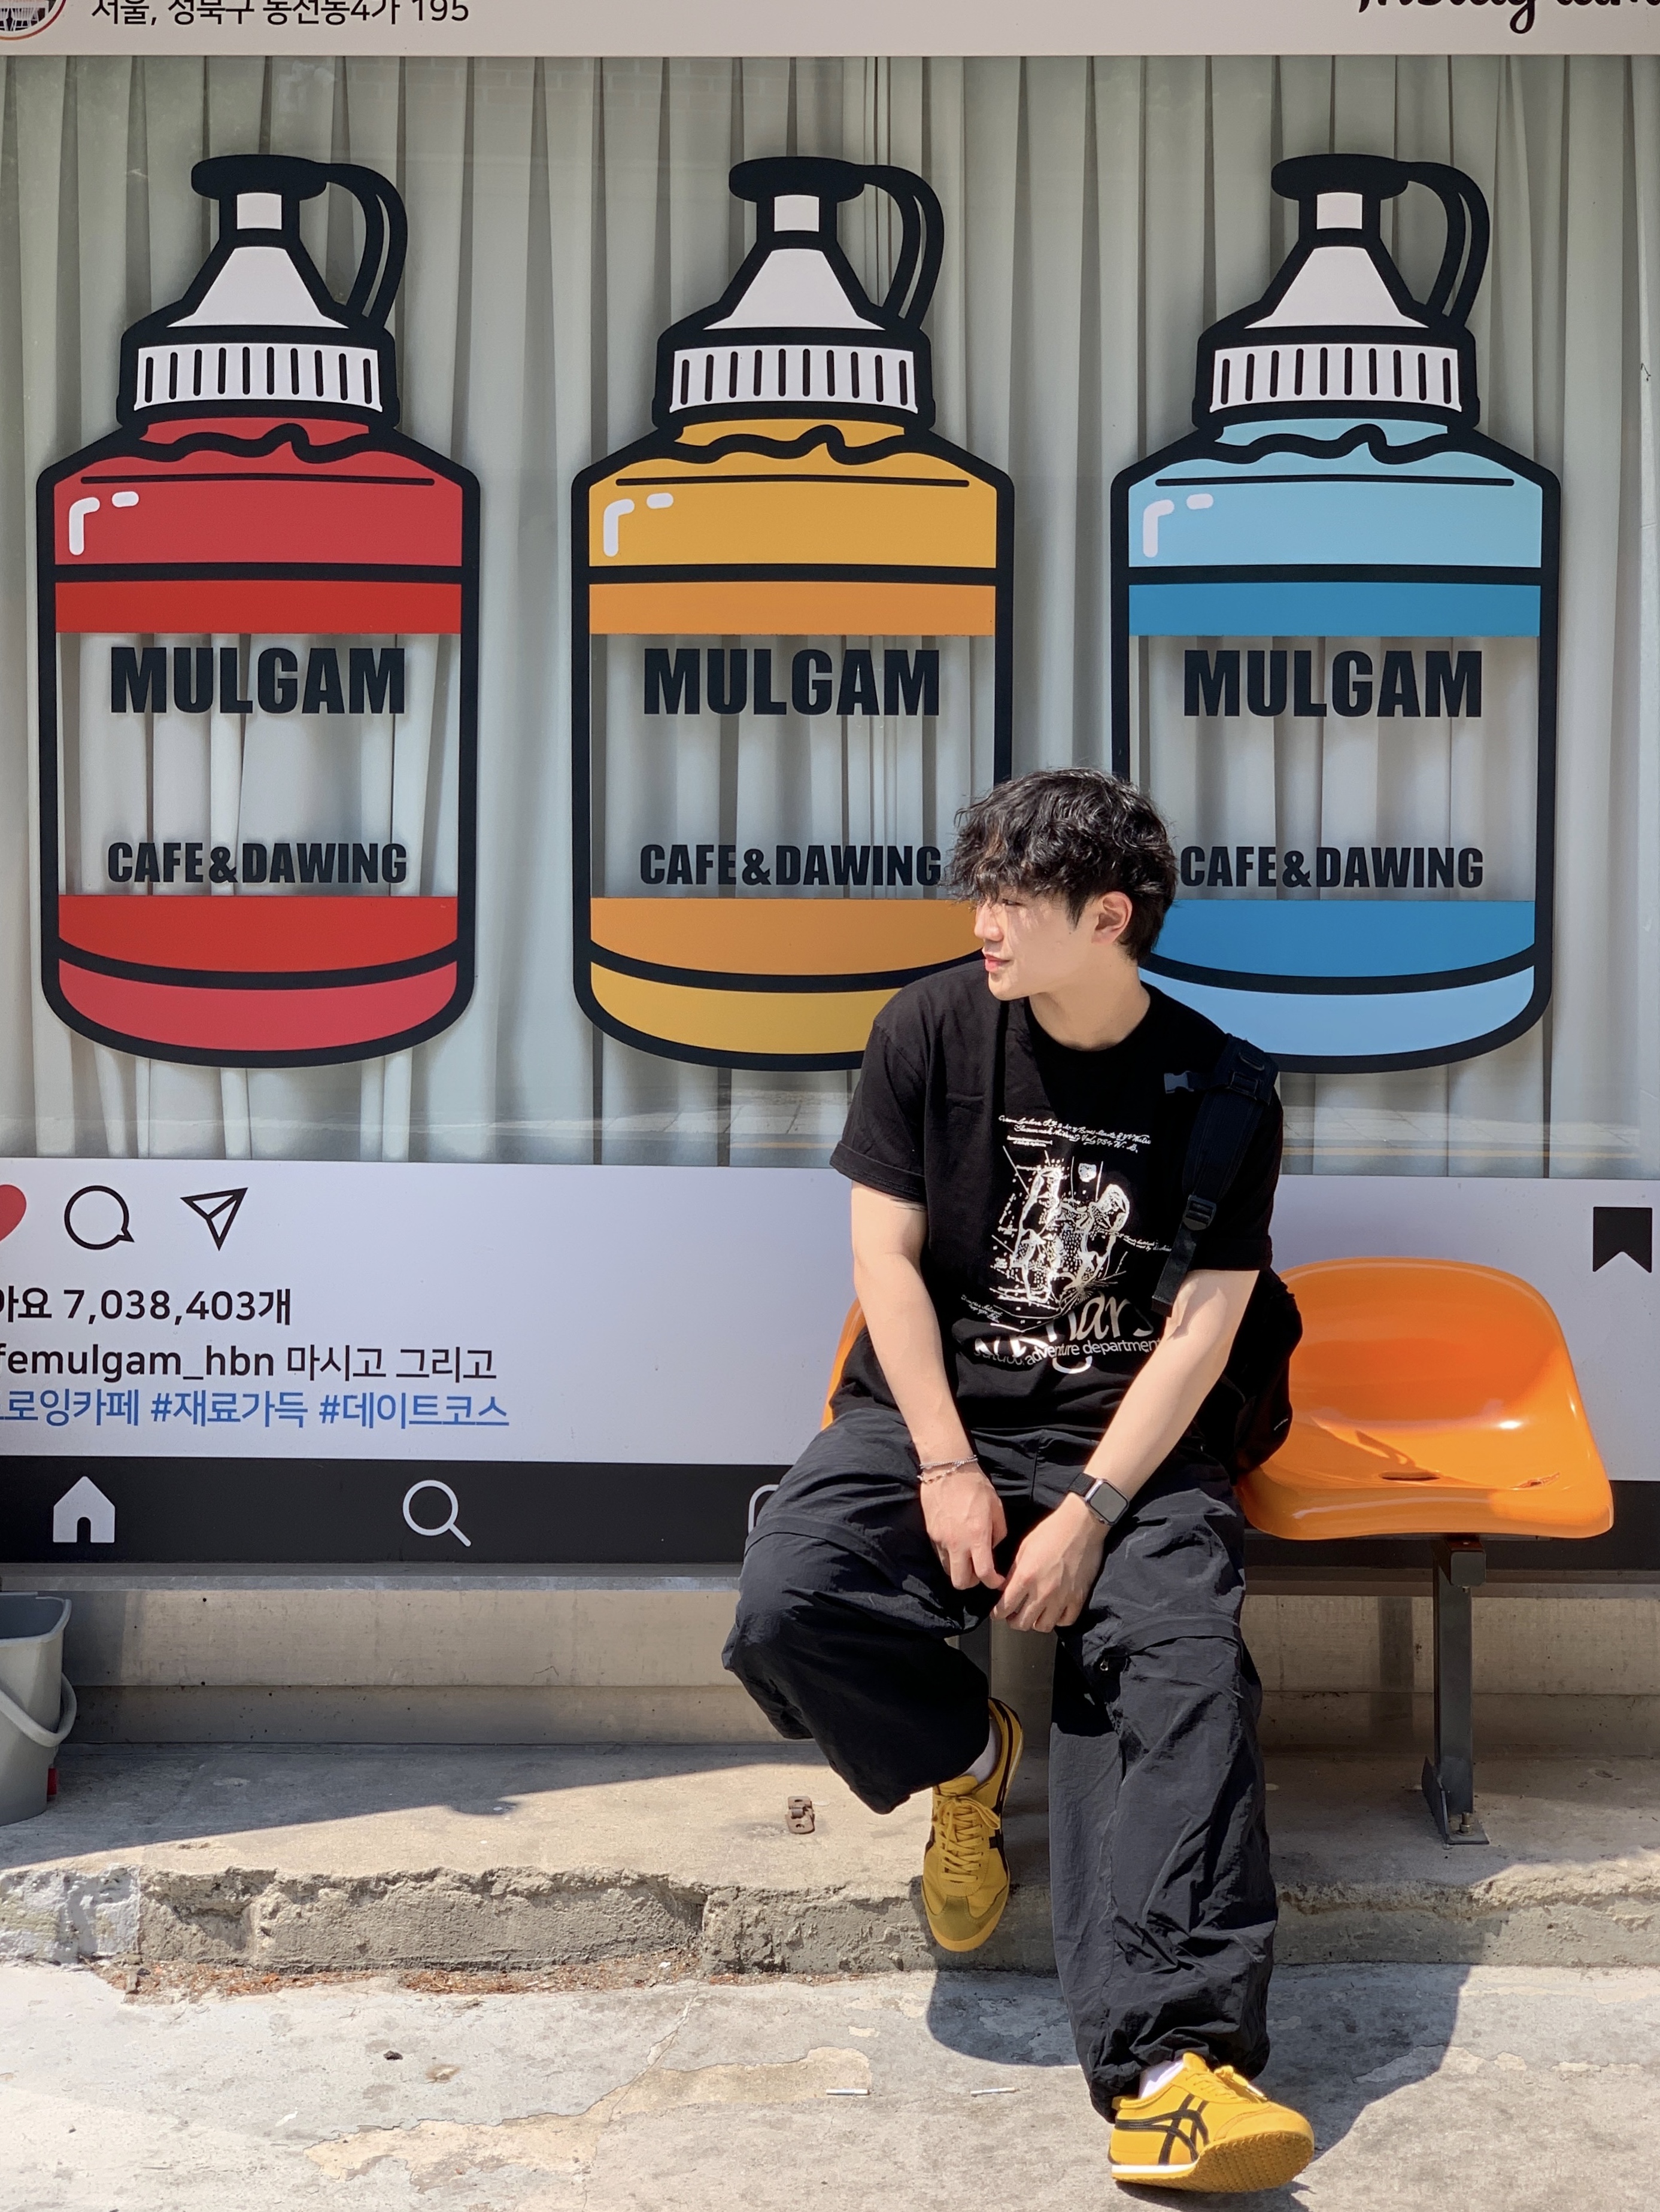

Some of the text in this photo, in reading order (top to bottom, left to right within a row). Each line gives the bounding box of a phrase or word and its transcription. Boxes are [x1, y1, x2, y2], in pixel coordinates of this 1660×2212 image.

[92, 0, 469, 26] 서울, 성북구 동선동4가 195
[111, 647, 405, 714] MULGAM
[644, 648, 939, 716] MULGAM
[1184, 649, 1482, 718] MULGAM
[108, 842, 407, 883] CAFE&DAWING
[1180, 846, 1483, 888] CAFE&DAWING
[63, 1289, 290, 1326] 7,038,403개
[287, 1345, 387, 1382] 마시고
[396, 1347, 497, 1383] 그리고
[1024, 1343, 1080, 1366] adventure
[0, 1388, 509, 1429] 로잉카페 #재료가득 #데이트코스
